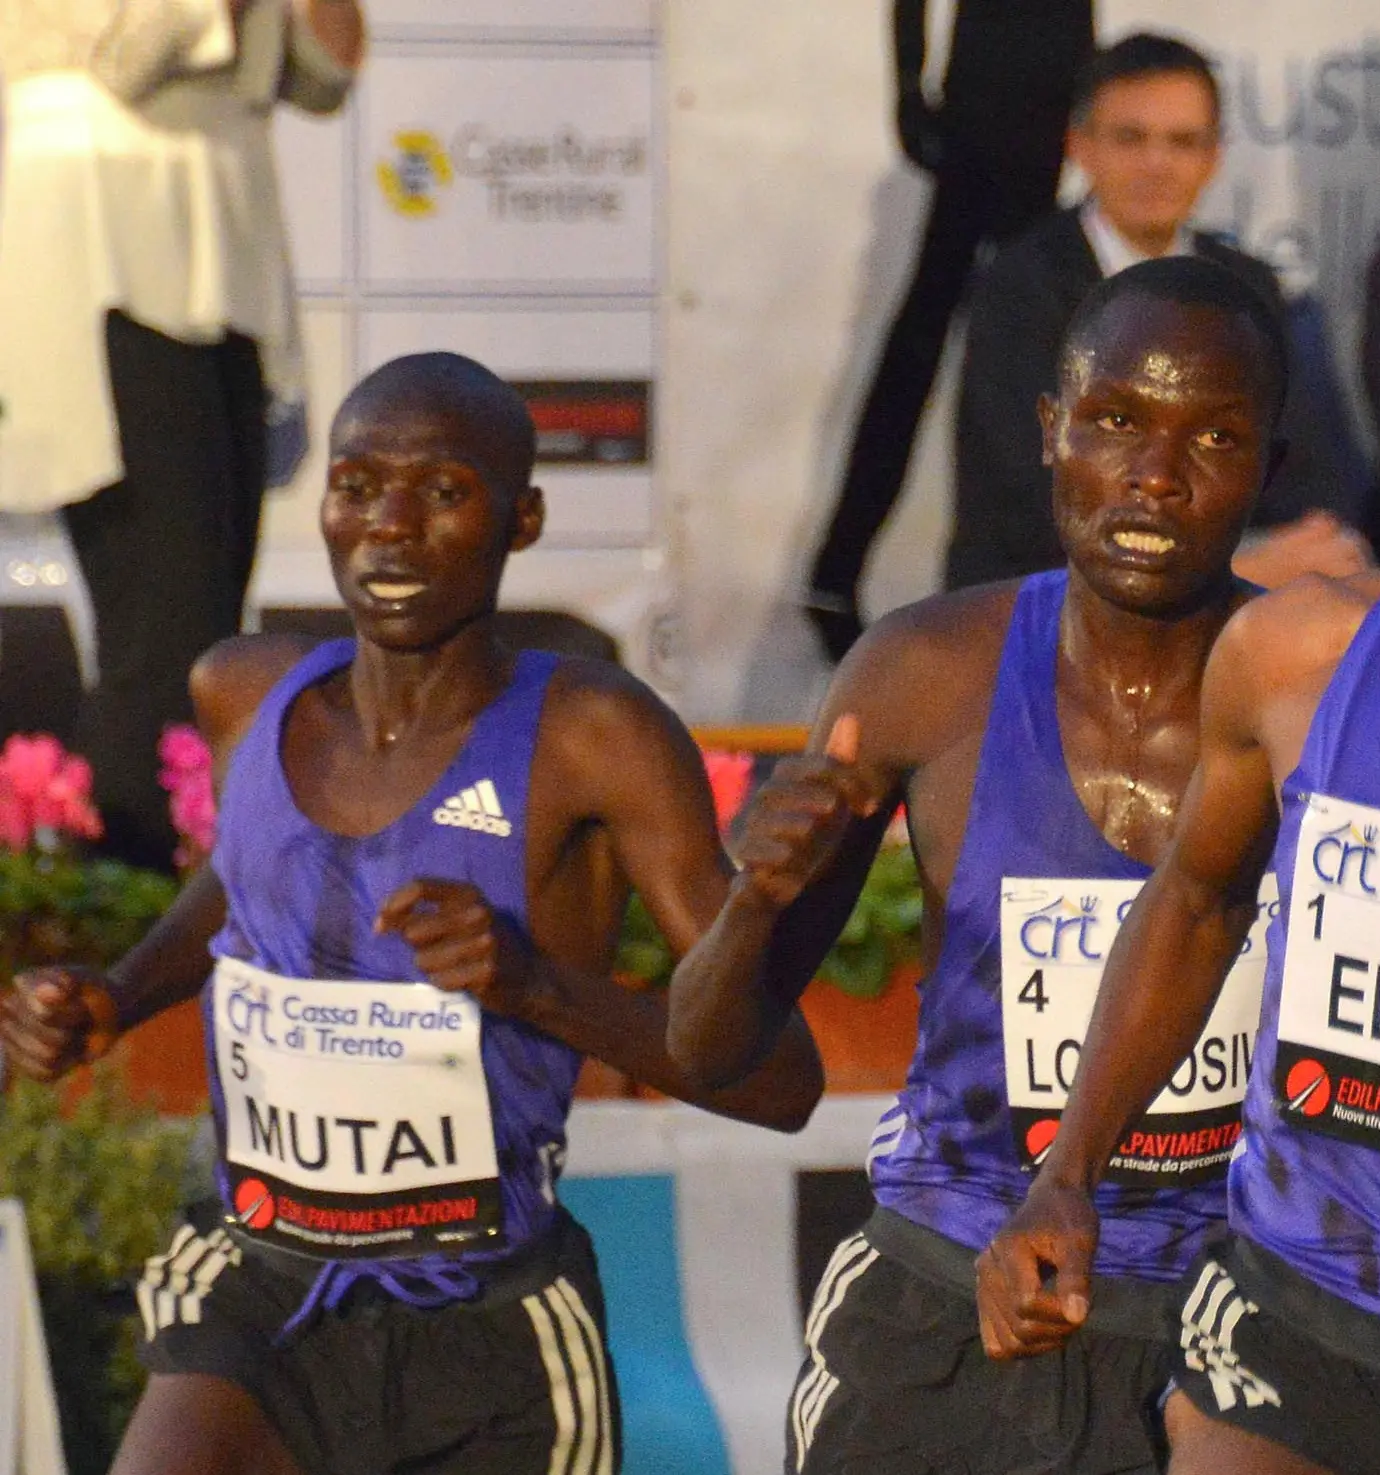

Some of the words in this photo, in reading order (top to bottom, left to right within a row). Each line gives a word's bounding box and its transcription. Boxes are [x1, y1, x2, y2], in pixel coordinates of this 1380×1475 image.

[432, 807, 512, 837] adidas
[1307, 893, 1326, 941] 1
[1018, 969, 1049, 1013] 4
[283, 996, 358, 1026] Cassa
[368, 1001, 462, 1032] Rurale
[285, 1026, 305, 1049] di
[315, 1028, 405, 1058] Trento
[231, 1041, 248, 1081] 5
[1332, 1103, 1364, 1125] Nuove
[245, 1096, 458, 1175] MUTAI
[1161, 1160, 1179, 1172] da
